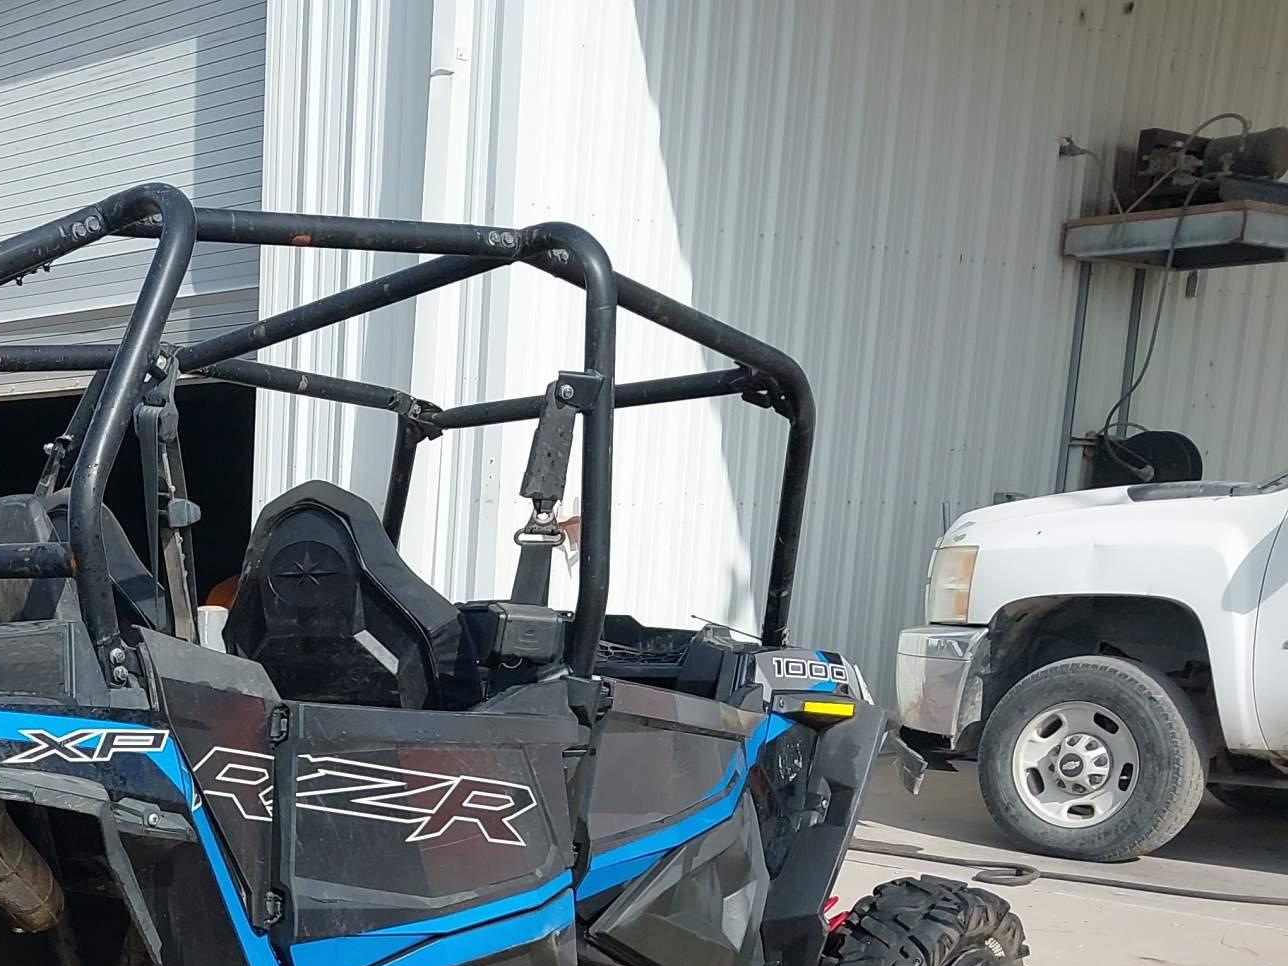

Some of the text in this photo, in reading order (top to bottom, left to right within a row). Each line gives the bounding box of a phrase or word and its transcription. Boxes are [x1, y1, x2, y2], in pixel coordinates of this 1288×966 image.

[772, 656, 849, 684] 1000
[0, 728, 169, 764] XP
[191, 746, 537, 846] RZR
